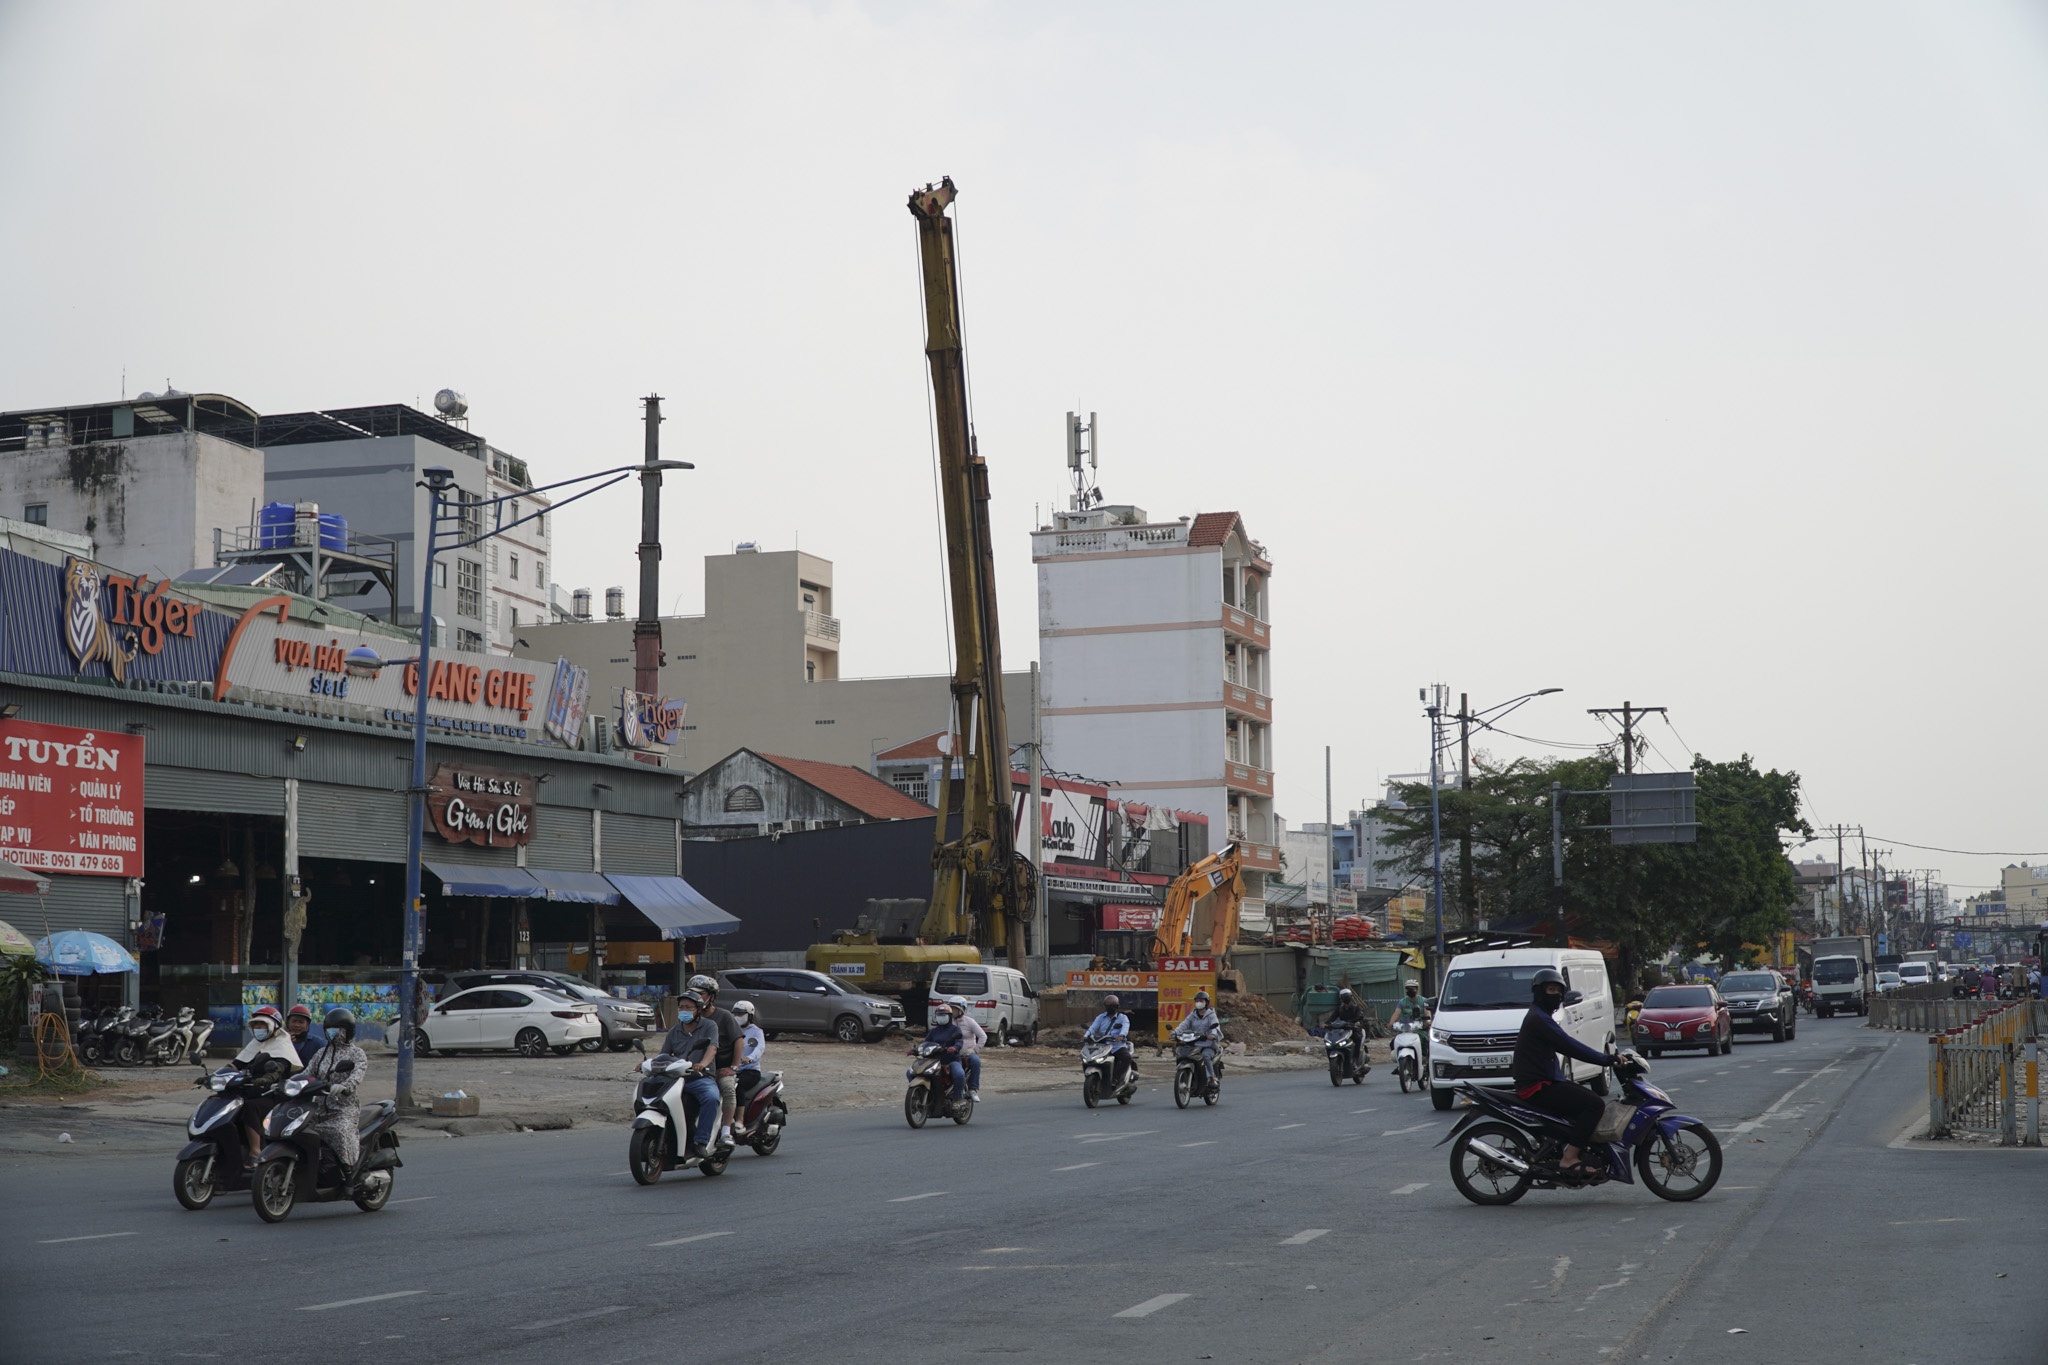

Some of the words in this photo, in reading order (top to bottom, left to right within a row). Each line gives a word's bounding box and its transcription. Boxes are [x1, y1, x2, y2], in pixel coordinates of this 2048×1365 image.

[107, 573, 203, 655] Tiger
[315, 639, 346, 673] HẢI
[484, 668, 536, 721] GHẸ
[641, 692, 683, 741] Tiger
[4, 733, 120, 772] TUYỂN
[28, 773, 51, 793] VIÊN
[80, 777, 107, 799] QUẢN
[110, 781, 122, 800] LÝ
[79, 802, 93, 823] TỔ
[95, 805, 134, 826] TRƯỞNG
[447, 798, 494, 844] Giang
[496, 804, 529, 836] Ghẹ
[17, 828, 32, 847] VỤ
[79, 830, 100, 849] VĂN
[102, 832, 137, 852] PHÒNG
[2, 850, 48, 866] HOTLINE:
[51, 854, 75, 868] 0961
[80, 856, 99, 869] 479
[101, 857, 120, 871] 686
[519, 931, 530, 942] 123
[831, 965, 848, 974] TRÁNH
[848, 966, 856, 974] XA
[856, 966, 865, 974] 2M
[1164, 960, 1209, 971] SALE
[1089, 974, 1140, 986] KOBELCO
[1159, 1003, 1182, 1021] 497
[1472, 1056, 1509, 1065] 51L-665.45
